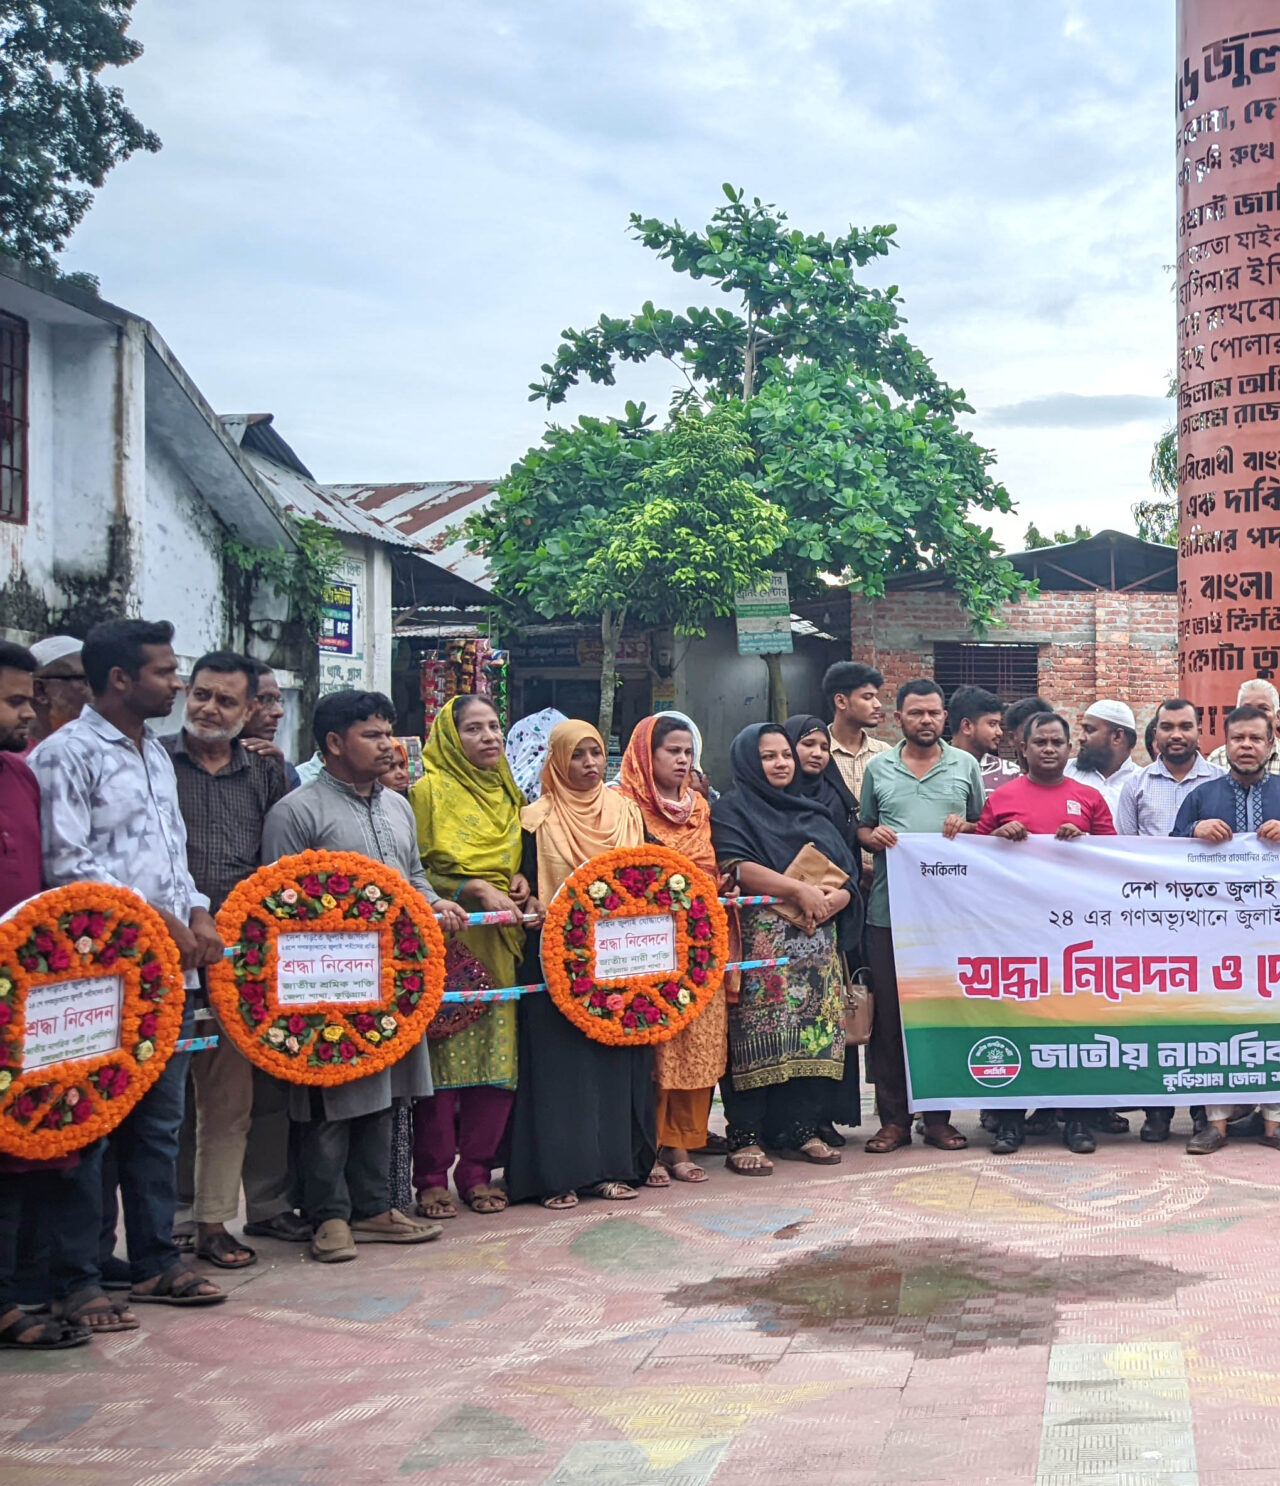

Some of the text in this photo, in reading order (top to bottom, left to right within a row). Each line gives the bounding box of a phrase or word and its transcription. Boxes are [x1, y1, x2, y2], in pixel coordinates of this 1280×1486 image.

[1230, 141, 1276, 168] রুখে
[1186, 491, 1217, 519] এক
[1200, 570, 1273, 602] বাংলা
[1188, 641, 1246, 673] কোটা
[920, 861, 968, 877] ইনকিলাব
[1122, 881, 1158, 900] দেশ
[1165, 881, 1218, 902] গড়তে
[1225, 875, 1278, 904] জুলাই
[1049, 909, 1075, 928] ২৪
[1084, 909, 1112, 927] এর
[598, 932, 669, 951] শ্রদ্ধা নিবেদনে
[282, 953, 375, 975] শ্রদ্ধা নিবেদন
[957, 956, 1049, 1000] শ্রদ্ধা
[1062, 940, 1199, 1001] নিবেদন
[1212, 955, 1243, 991] ও
[26, 1004, 115, 1038] শ্রদ্ধা নিবেদন
[1029, 1033, 1149, 1071] জাতীয়
[1162, 1069, 1224, 1093] কুড়িগ্রাম
[1229, 1071, 1266, 1088] জেলা
